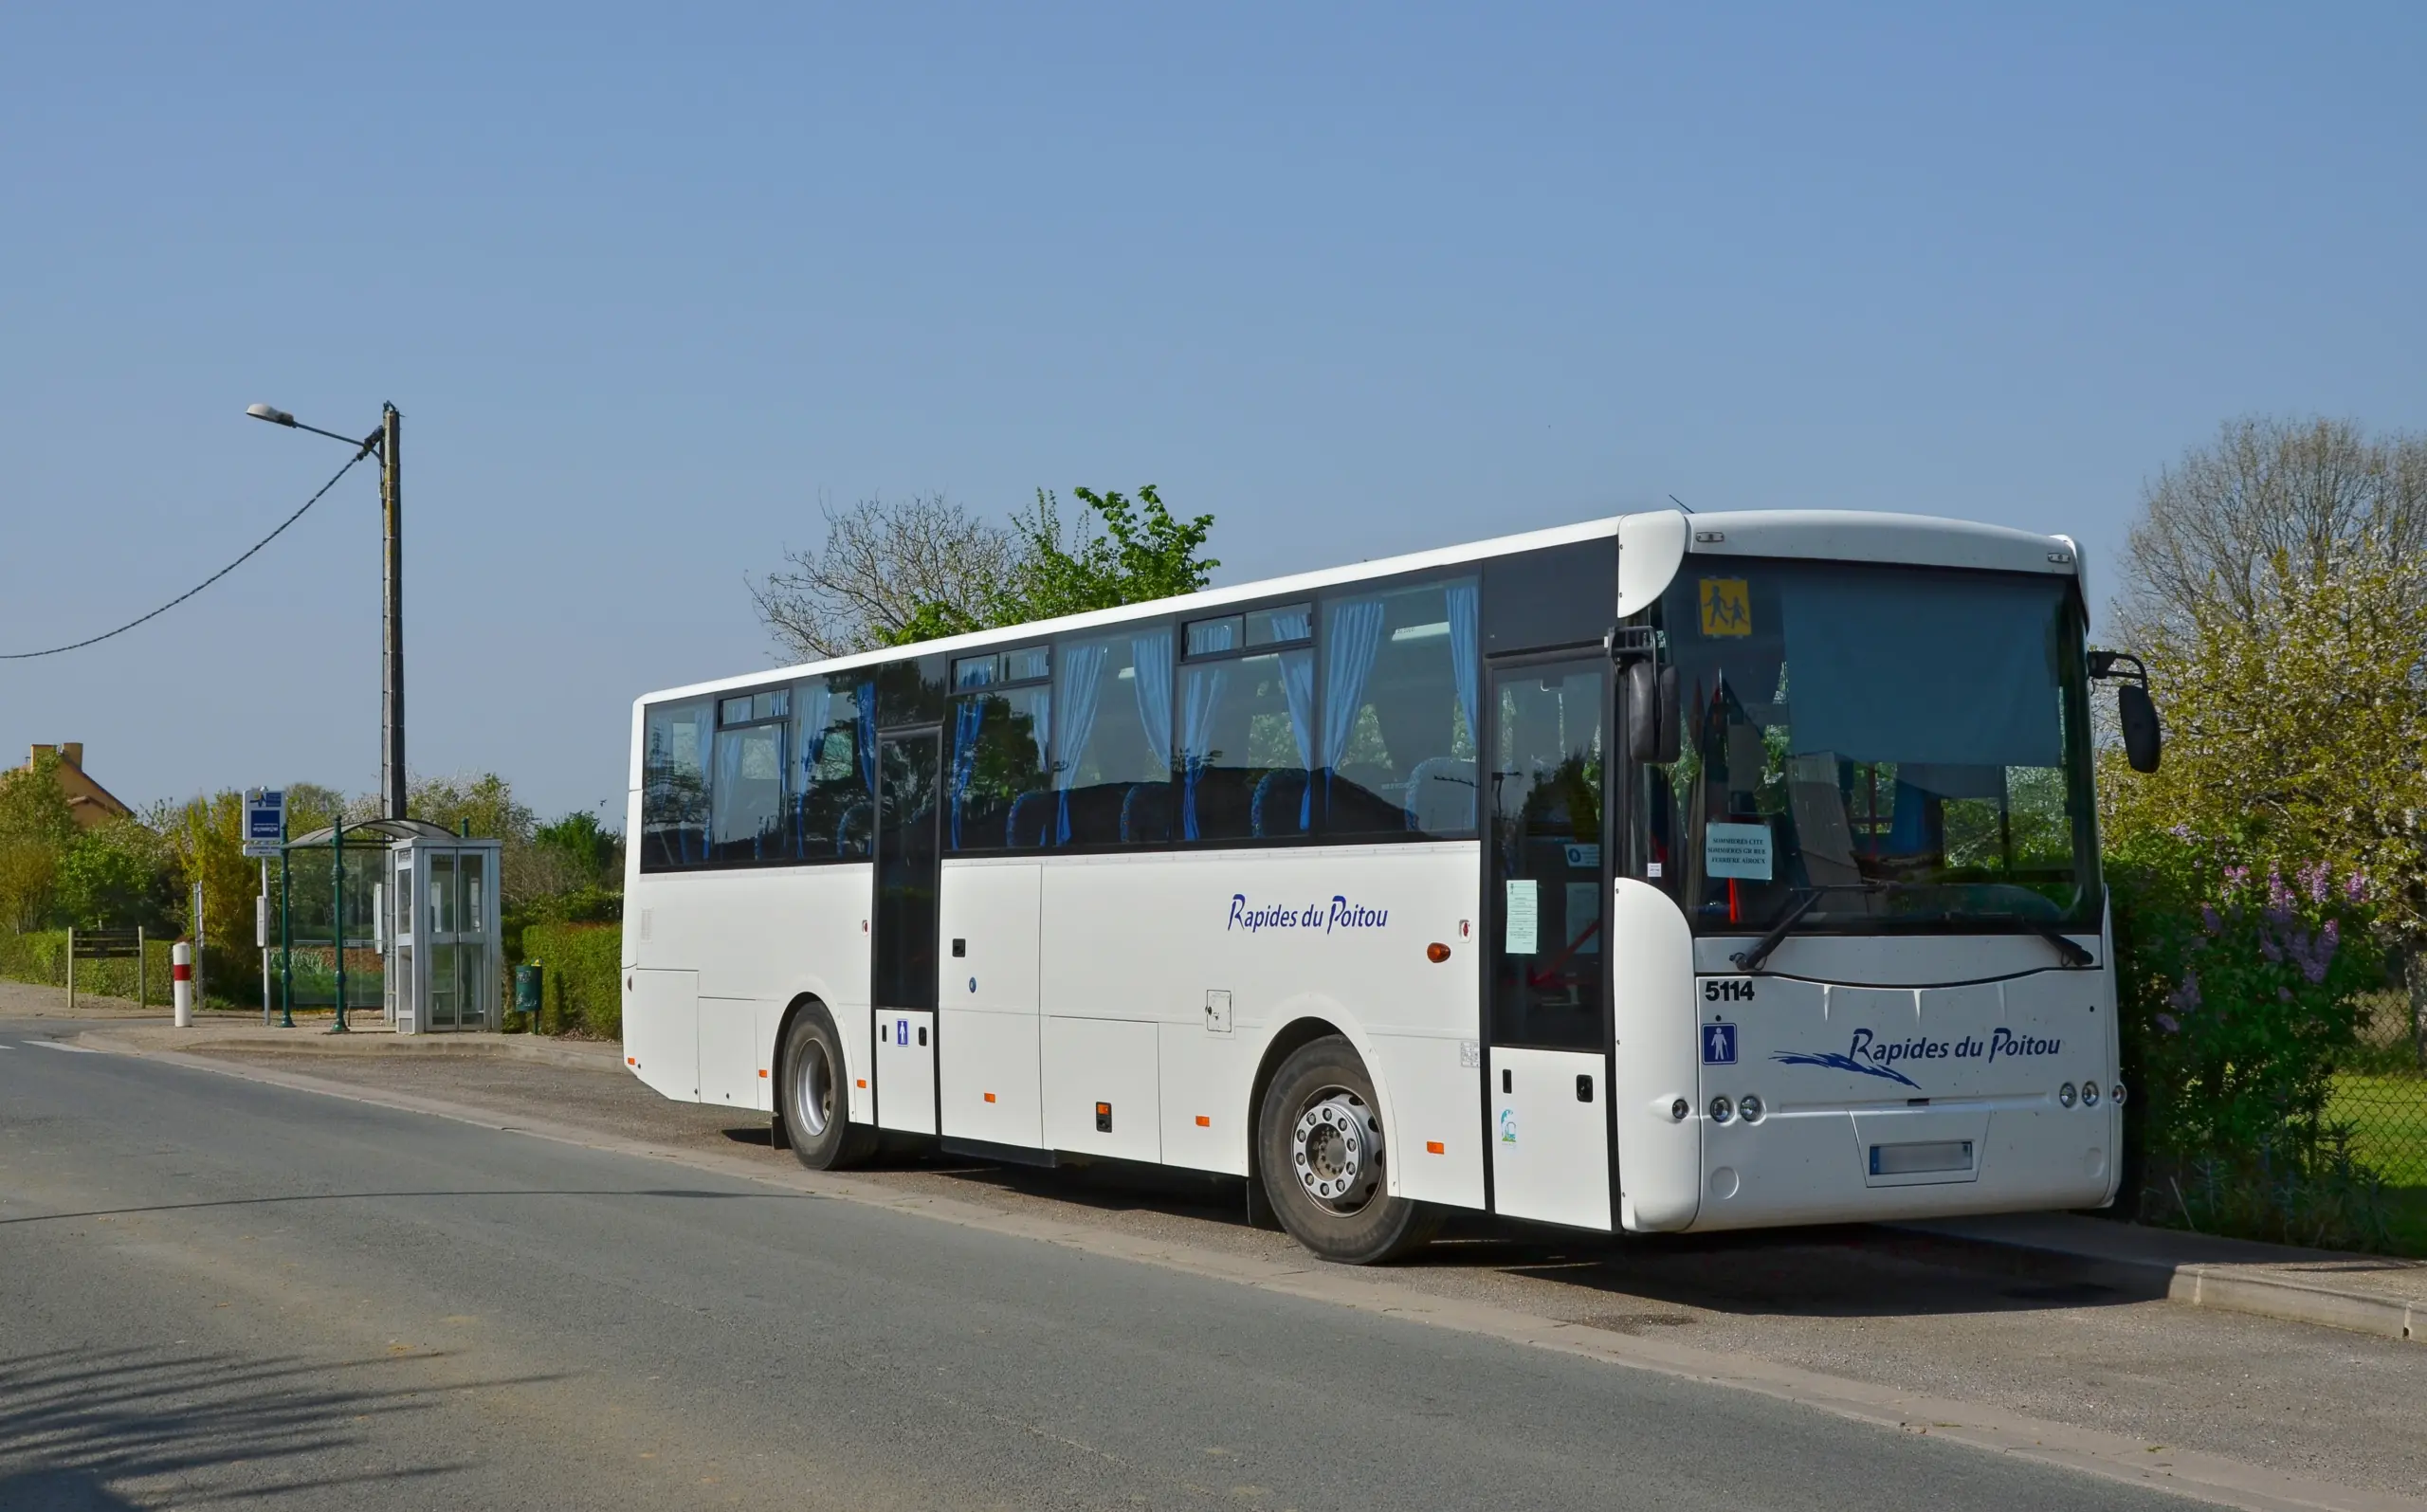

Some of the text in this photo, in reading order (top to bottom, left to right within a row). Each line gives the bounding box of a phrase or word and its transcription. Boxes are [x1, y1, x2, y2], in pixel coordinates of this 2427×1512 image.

[1228, 893, 1389, 935] Rapides du Poitou
[1705, 980, 1755, 1001] 5114
[1849, 1028, 2061, 1065] Rapides du Poitou
